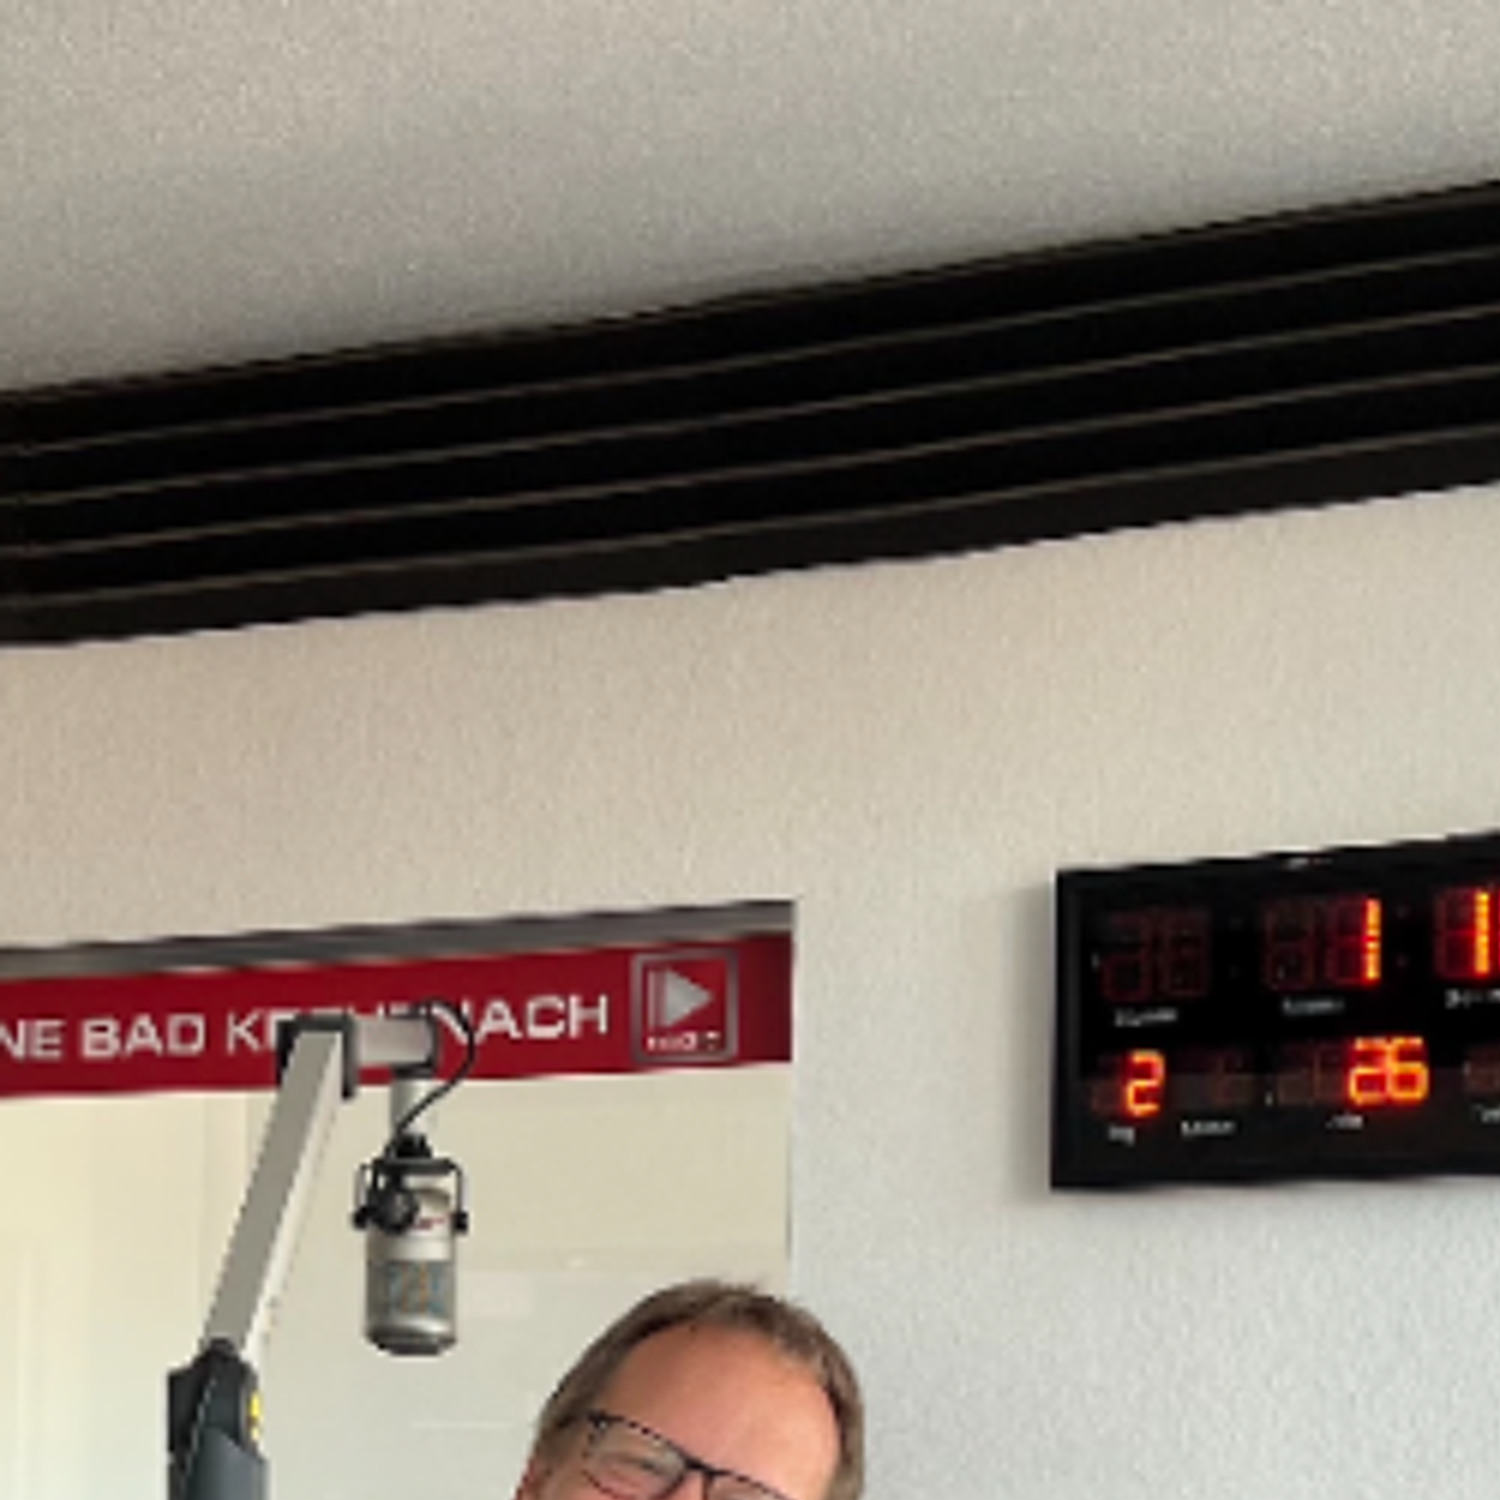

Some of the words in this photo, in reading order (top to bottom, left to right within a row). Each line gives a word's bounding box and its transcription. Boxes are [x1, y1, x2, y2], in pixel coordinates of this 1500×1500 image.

[79, 1012, 206, 1060] BAD
[225, 992, 610, 1056] KNACH
[1348, 1036, 1430, 1107] 26
